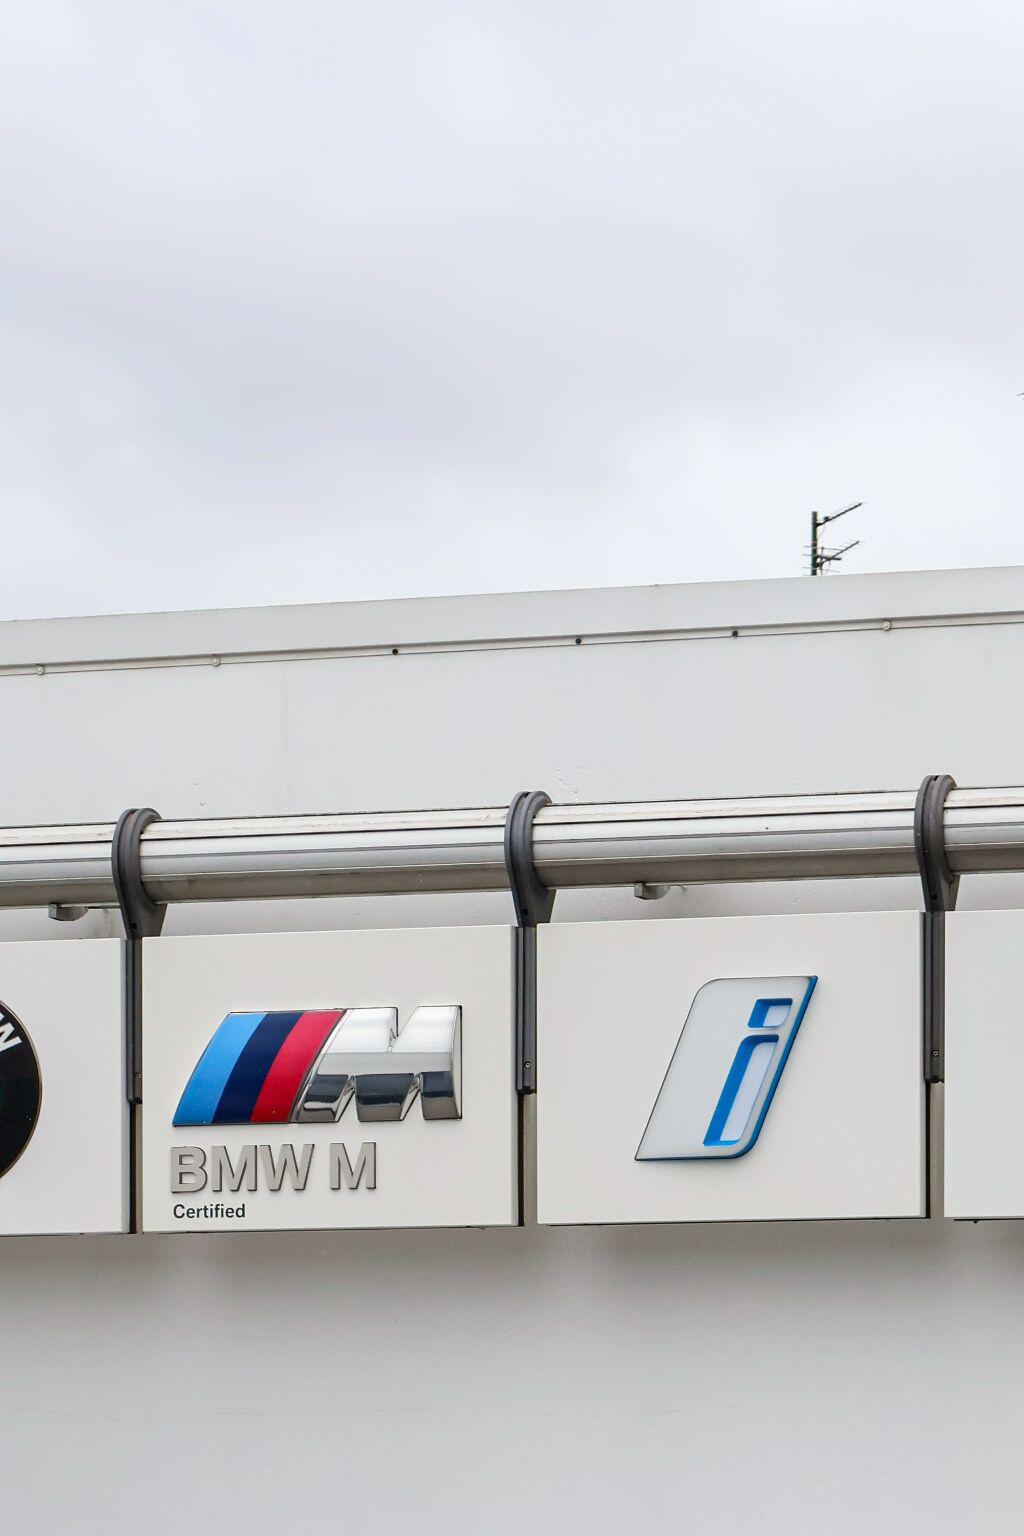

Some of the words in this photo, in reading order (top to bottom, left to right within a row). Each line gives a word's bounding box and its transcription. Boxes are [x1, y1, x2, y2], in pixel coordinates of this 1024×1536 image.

[170, 1143, 315, 1193] BMW
[330, 1142, 377, 1190] M
[173, 1203, 246, 1219] Certified
